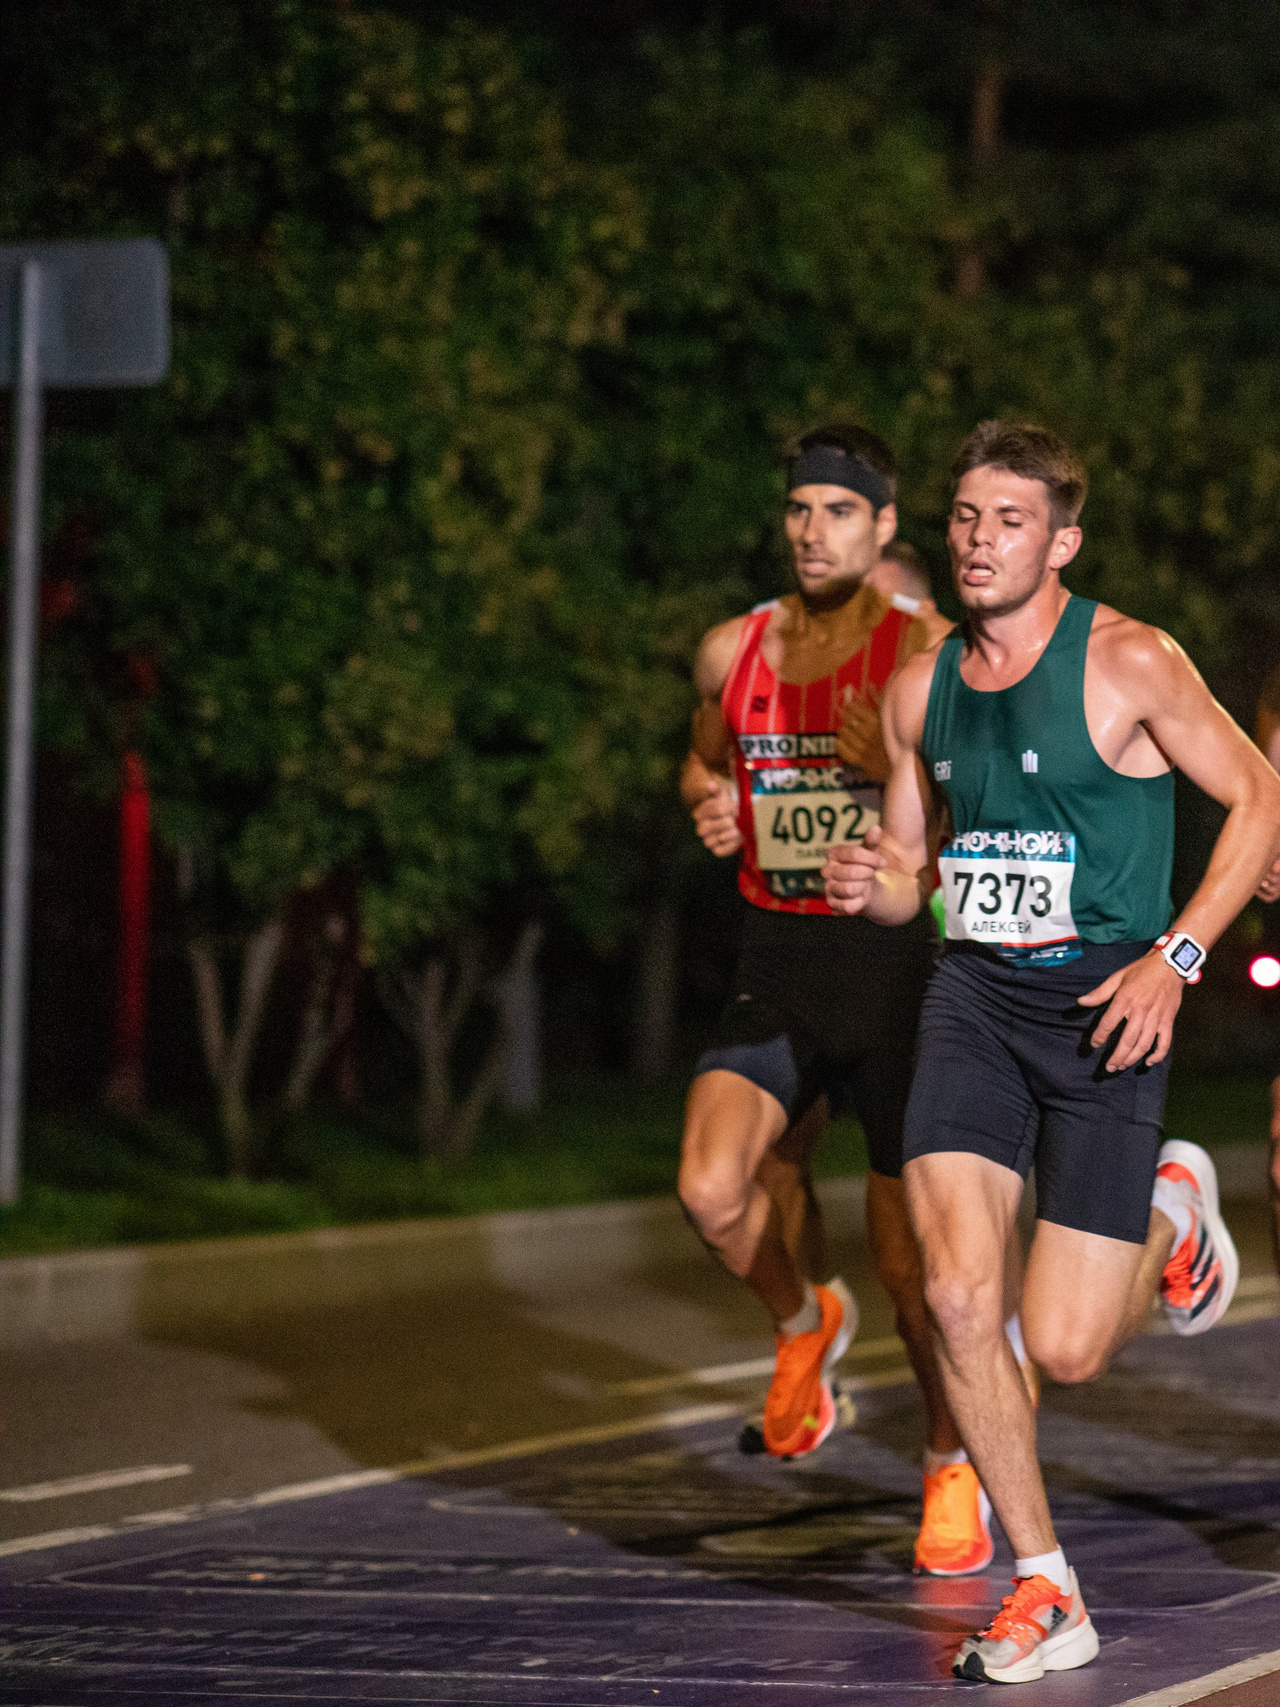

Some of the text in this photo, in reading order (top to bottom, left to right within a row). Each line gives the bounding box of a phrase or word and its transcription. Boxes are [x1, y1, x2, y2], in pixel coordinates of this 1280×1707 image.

[771, 804, 865, 844] 4092
[952, 829, 1063, 855] НОЧНОЙ
[954, 872, 1052, 917] 7373
[971, 920, 1032, 934] АЛЕКСЕЙ
